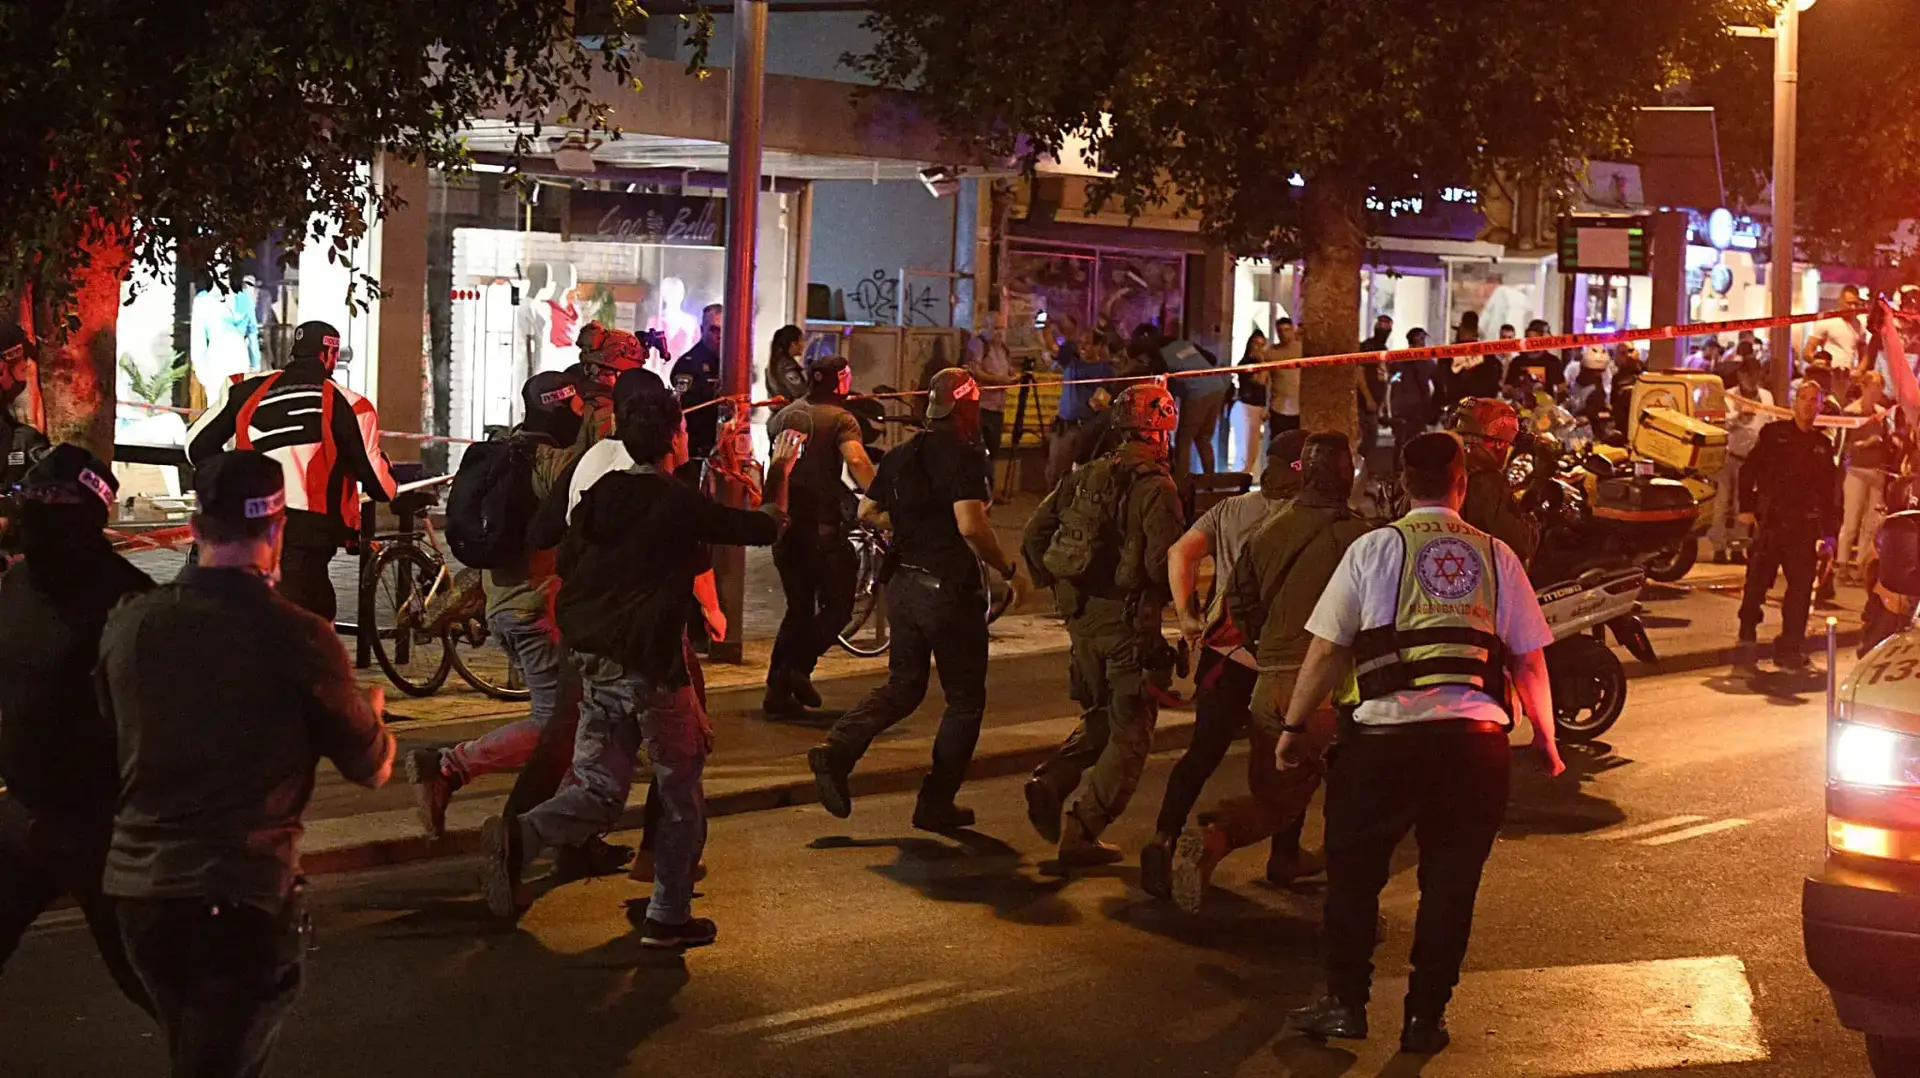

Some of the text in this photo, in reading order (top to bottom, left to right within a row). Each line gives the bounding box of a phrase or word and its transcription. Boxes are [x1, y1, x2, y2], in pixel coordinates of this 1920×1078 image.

[1405, 521, 1443, 533] בכיר
[1444, 603, 1471, 614] DAVID
[1867, 658, 1920, 686] 13
